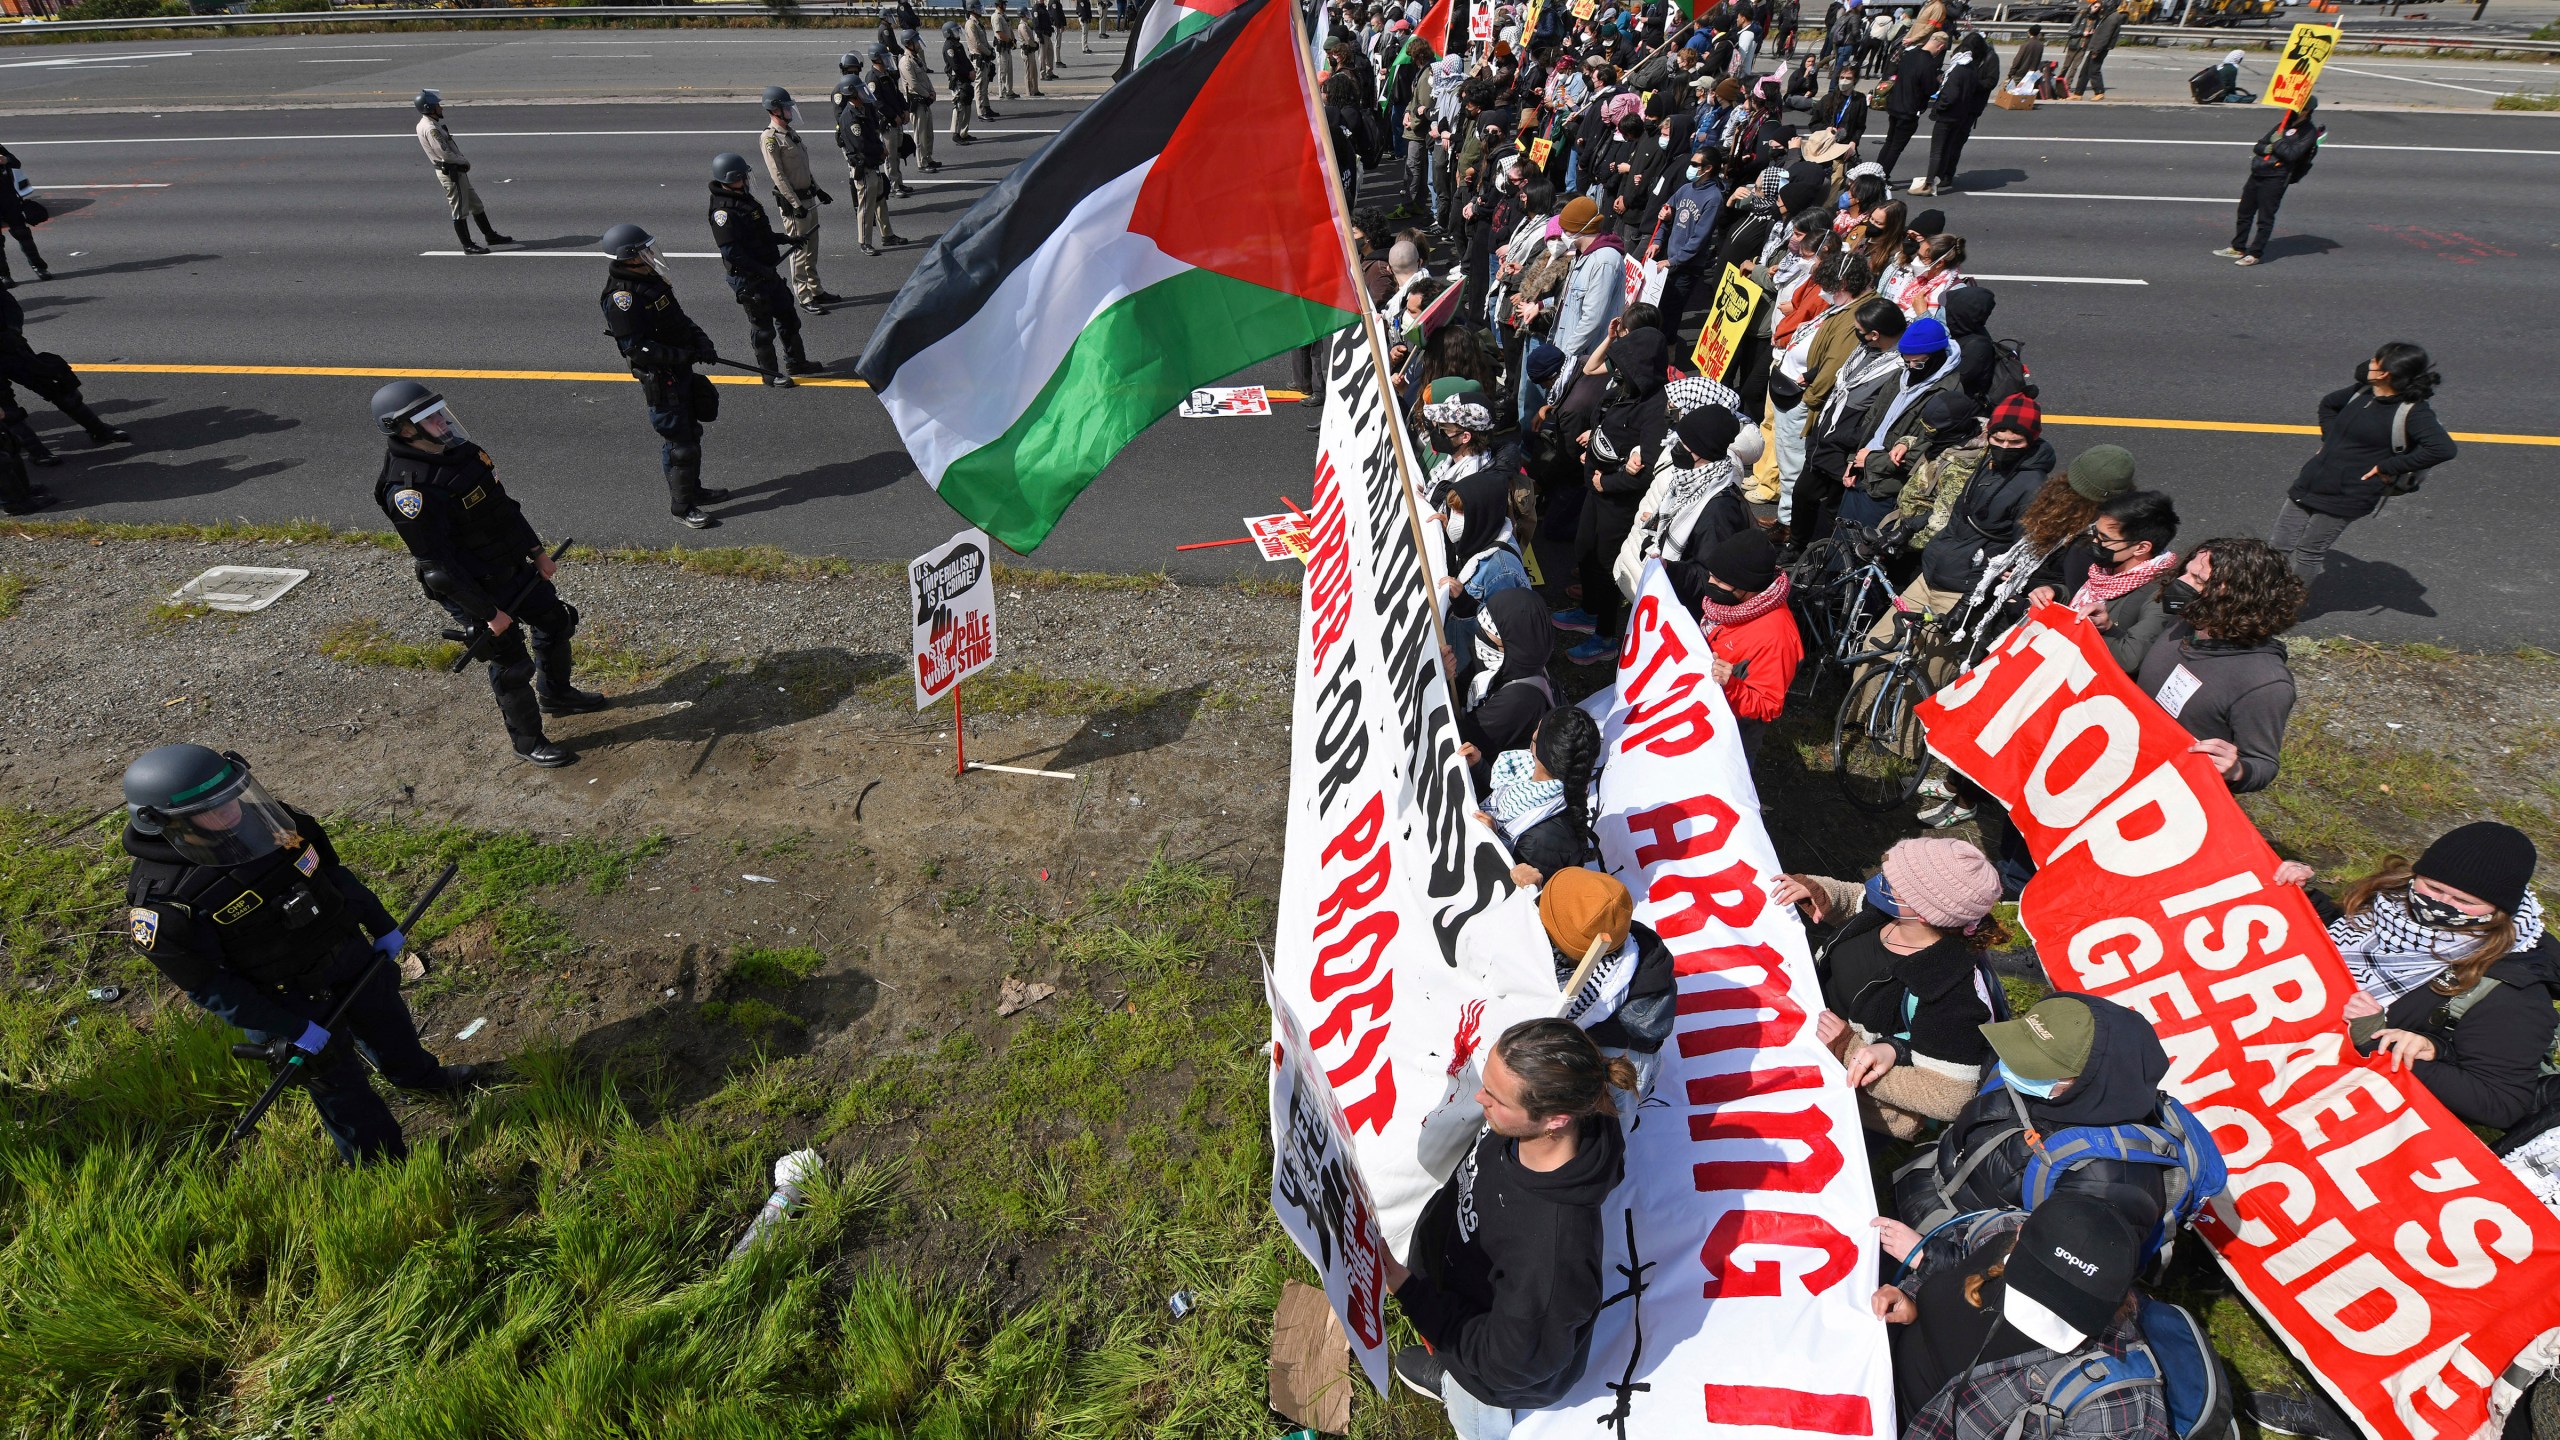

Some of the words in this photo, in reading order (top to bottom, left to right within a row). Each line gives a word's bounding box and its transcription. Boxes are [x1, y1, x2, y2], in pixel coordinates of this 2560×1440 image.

[1686, 198, 1702, 222] VEGAS
[913, 561, 931, 583] U.S.
[922, 551, 980, 595] IMPERIALISM
[1307, 450, 1353, 677] MURDER
[926, 590, 937, 609] IS
[945, 569, 977, 600] CRIME!
[957, 613, 992, 647] PALE
[965, 609, 979, 625] for
[928, 630, 953, 660] STOP
[933, 652, 948, 670] THE
[957, 635, 993, 674] STINE
[923, 654, 957, 692] WORLD
[1618, 595, 1715, 758] STOP
[1315, 639, 1369, 819] FOR
[1374, 515, 1517, 968] DEMANDS
[227, 900, 246, 914] CHP
[1308, 790, 1400, 1137] PROFIT
[1629, 794, 1859, 1299] ARMING
[2159, 870, 2535, 1290] ISRAEL'S
[2067, 916, 2496, 1440] GENOCIDE
[1343, 1193, 1358, 1285] STOP
[1360, 1218, 1379, 1343] WORLD
[2054, 1246, 2100, 1277] gopuff
